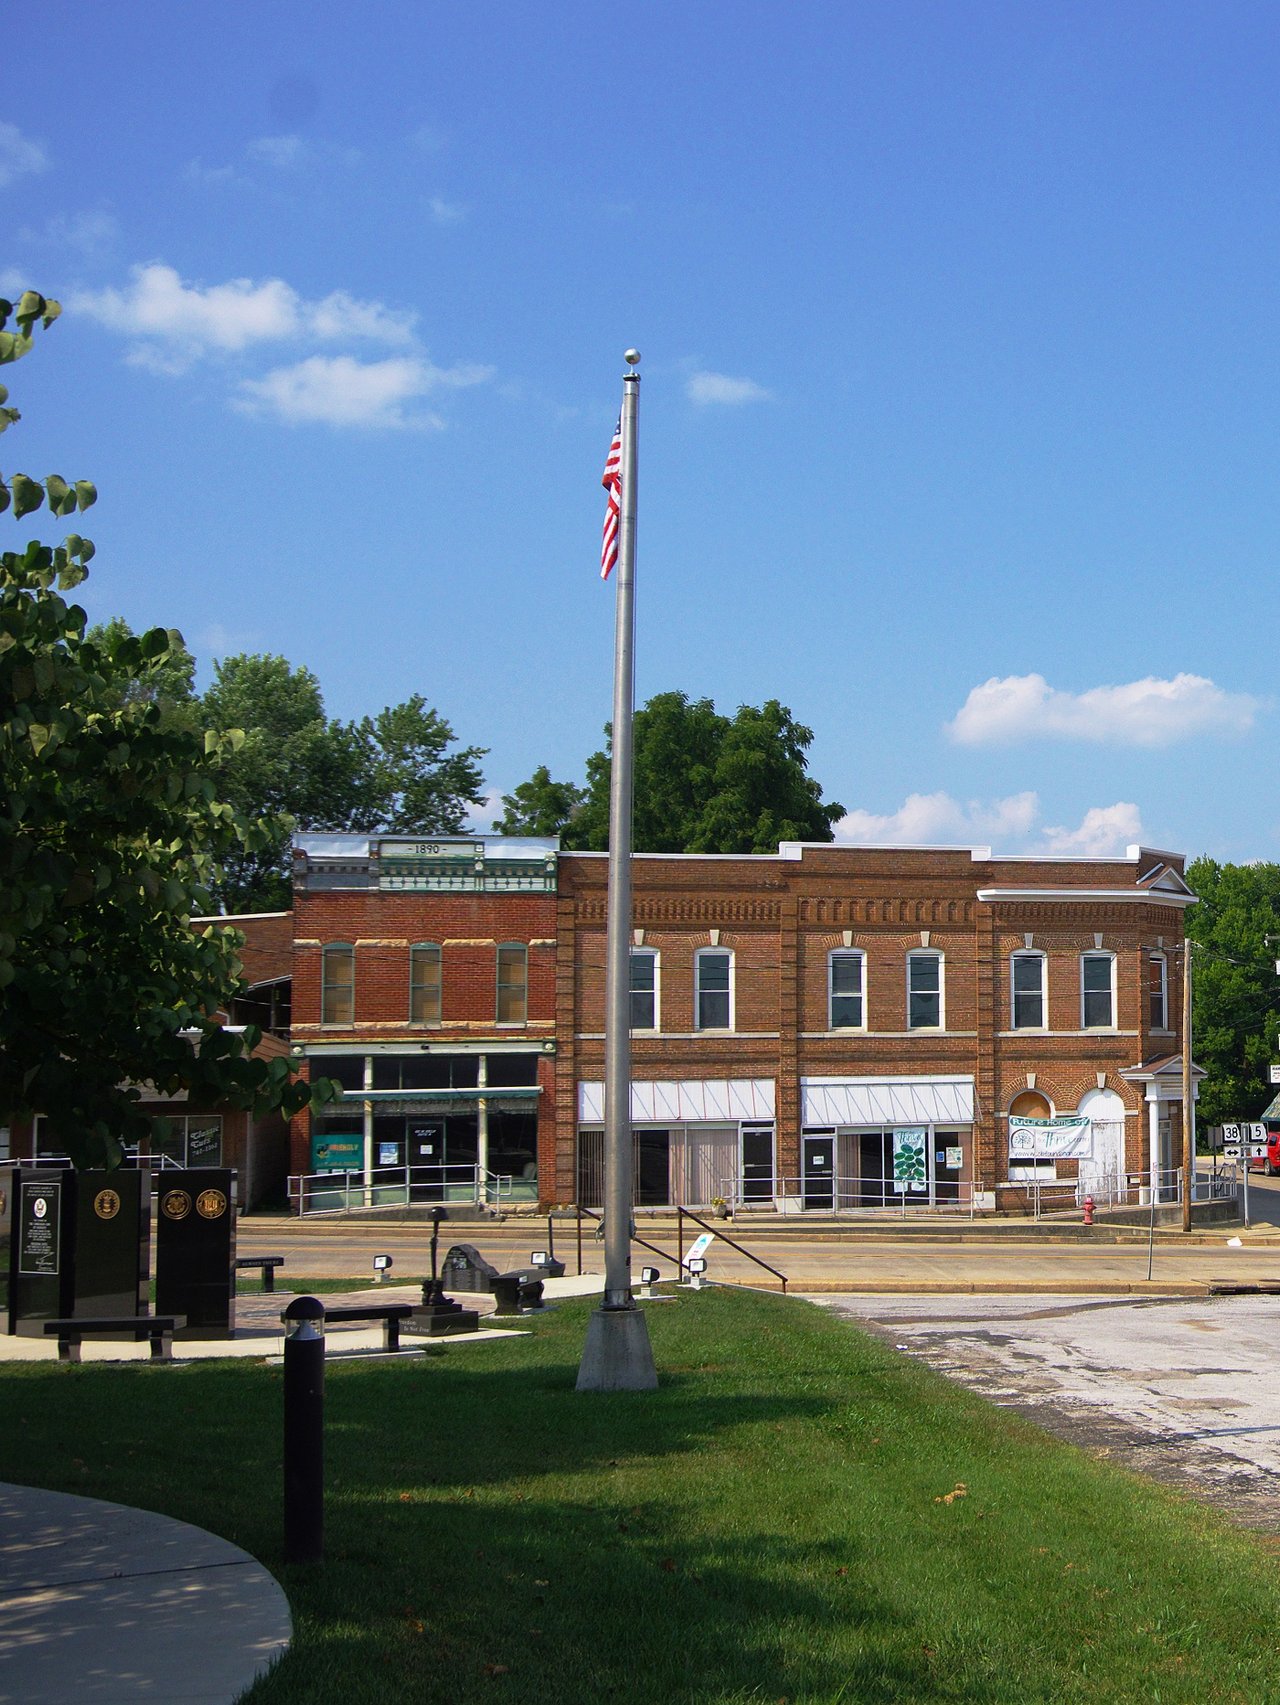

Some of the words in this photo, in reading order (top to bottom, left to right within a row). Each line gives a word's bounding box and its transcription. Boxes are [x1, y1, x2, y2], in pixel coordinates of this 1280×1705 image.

[1012, 1118, 1044, 1126] Future
[1046, 1118, 1072, 1126] Home
[1225, 1127, 1238, 1139] 38
[1255, 1126, 1262, 1137] 5
